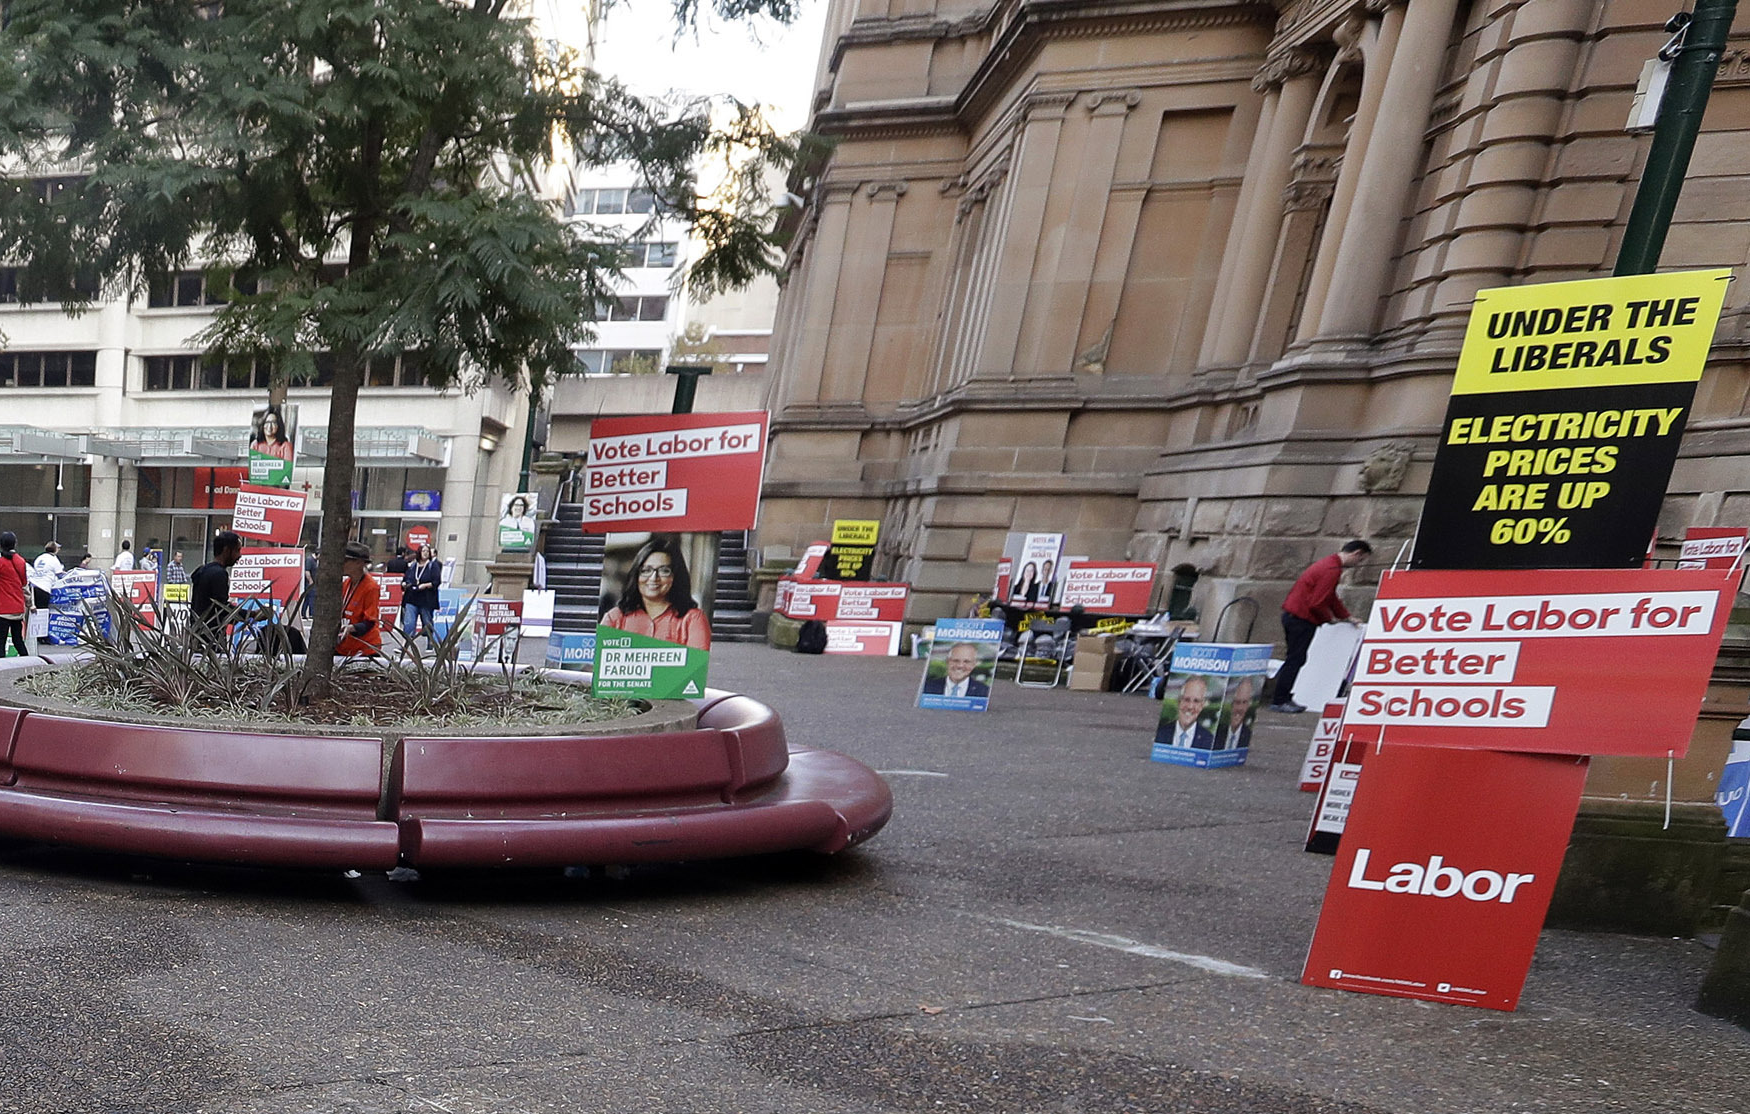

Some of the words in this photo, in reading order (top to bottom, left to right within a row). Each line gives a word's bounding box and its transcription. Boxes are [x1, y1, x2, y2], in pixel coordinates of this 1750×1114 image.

[1487, 303, 1613, 339] UNDER
[1625, 297, 1700, 329] THE
[1489, 335, 1673, 374] LIBERALS
[1446, 407, 1683, 445] ELECTRICITY
[591, 440, 640, 461] Vote
[646, 434, 714, 456] Labor
[719, 430, 753, 450] for
[1482, 446, 1620, 477] PRICES
[590, 467, 661, 489] Better
[239, 494, 256, 504] Vote
[258, 495, 284, 507] Labor
[286, 498, 300, 509] for
[1471, 483, 1550, 512] ARE
[1557, 481, 1611, 510] UP
[588, 493, 674, 516] Schools
[236, 507, 262, 518] Better
[234, 519, 266, 532] Schools
[1490, 517, 1571, 545] 60%
[254, 556, 281, 565] Labor
[283, 556, 297, 565] for
[233, 570, 260, 578] Better
[1070, 571, 1093, 579] Vote
[1096, 570, 1128, 579] Labor
[1131, 569, 1148, 579] for
[232, 582, 266, 591] Schools
[864, 588, 889, 596] Labor
[1065, 595, 1107, 604] Schools
[839, 608, 874, 616] Schools
[1379, 606, 1472, 632] Vote
[1481, 601, 1621, 631] Labor
[1629, 597, 1702, 629] for
[955, 621, 985, 629] SCOTT
[937, 628, 1000, 640] MORRISON
[605, 652, 621, 662] DR
[624, 651, 682, 662] MEHREEN
[1191, 648, 1219, 657] SCOTT
[1174, 656, 1231, 672] MORRISON
[1366, 648, 1505, 675] Better
[604, 665, 647, 676] FARUQI
[1357, 688, 1527, 718] Schools
[1348, 848, 1535, 903] Labor
